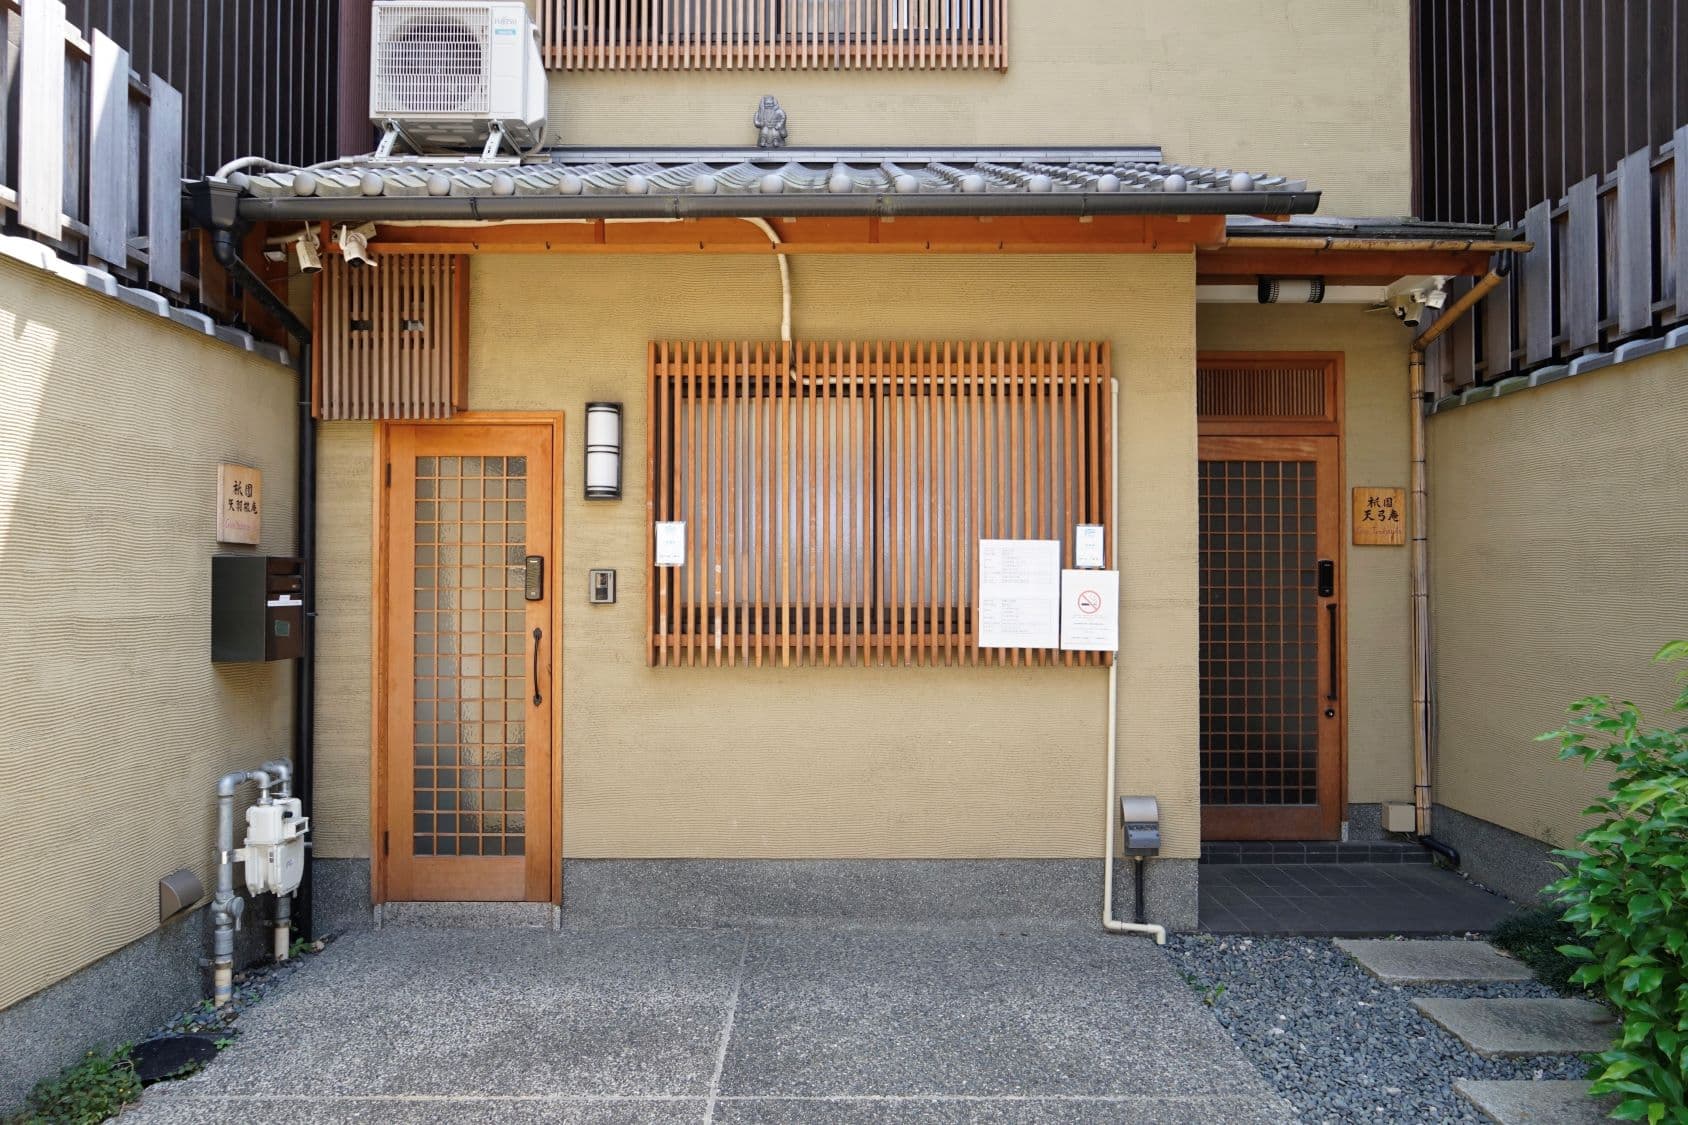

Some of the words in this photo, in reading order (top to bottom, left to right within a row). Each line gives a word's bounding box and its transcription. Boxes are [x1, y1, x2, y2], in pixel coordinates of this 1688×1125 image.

[1367, 496, 1393, 508] 祇園
[1362, 509, 1399, 522] 天弓庵
